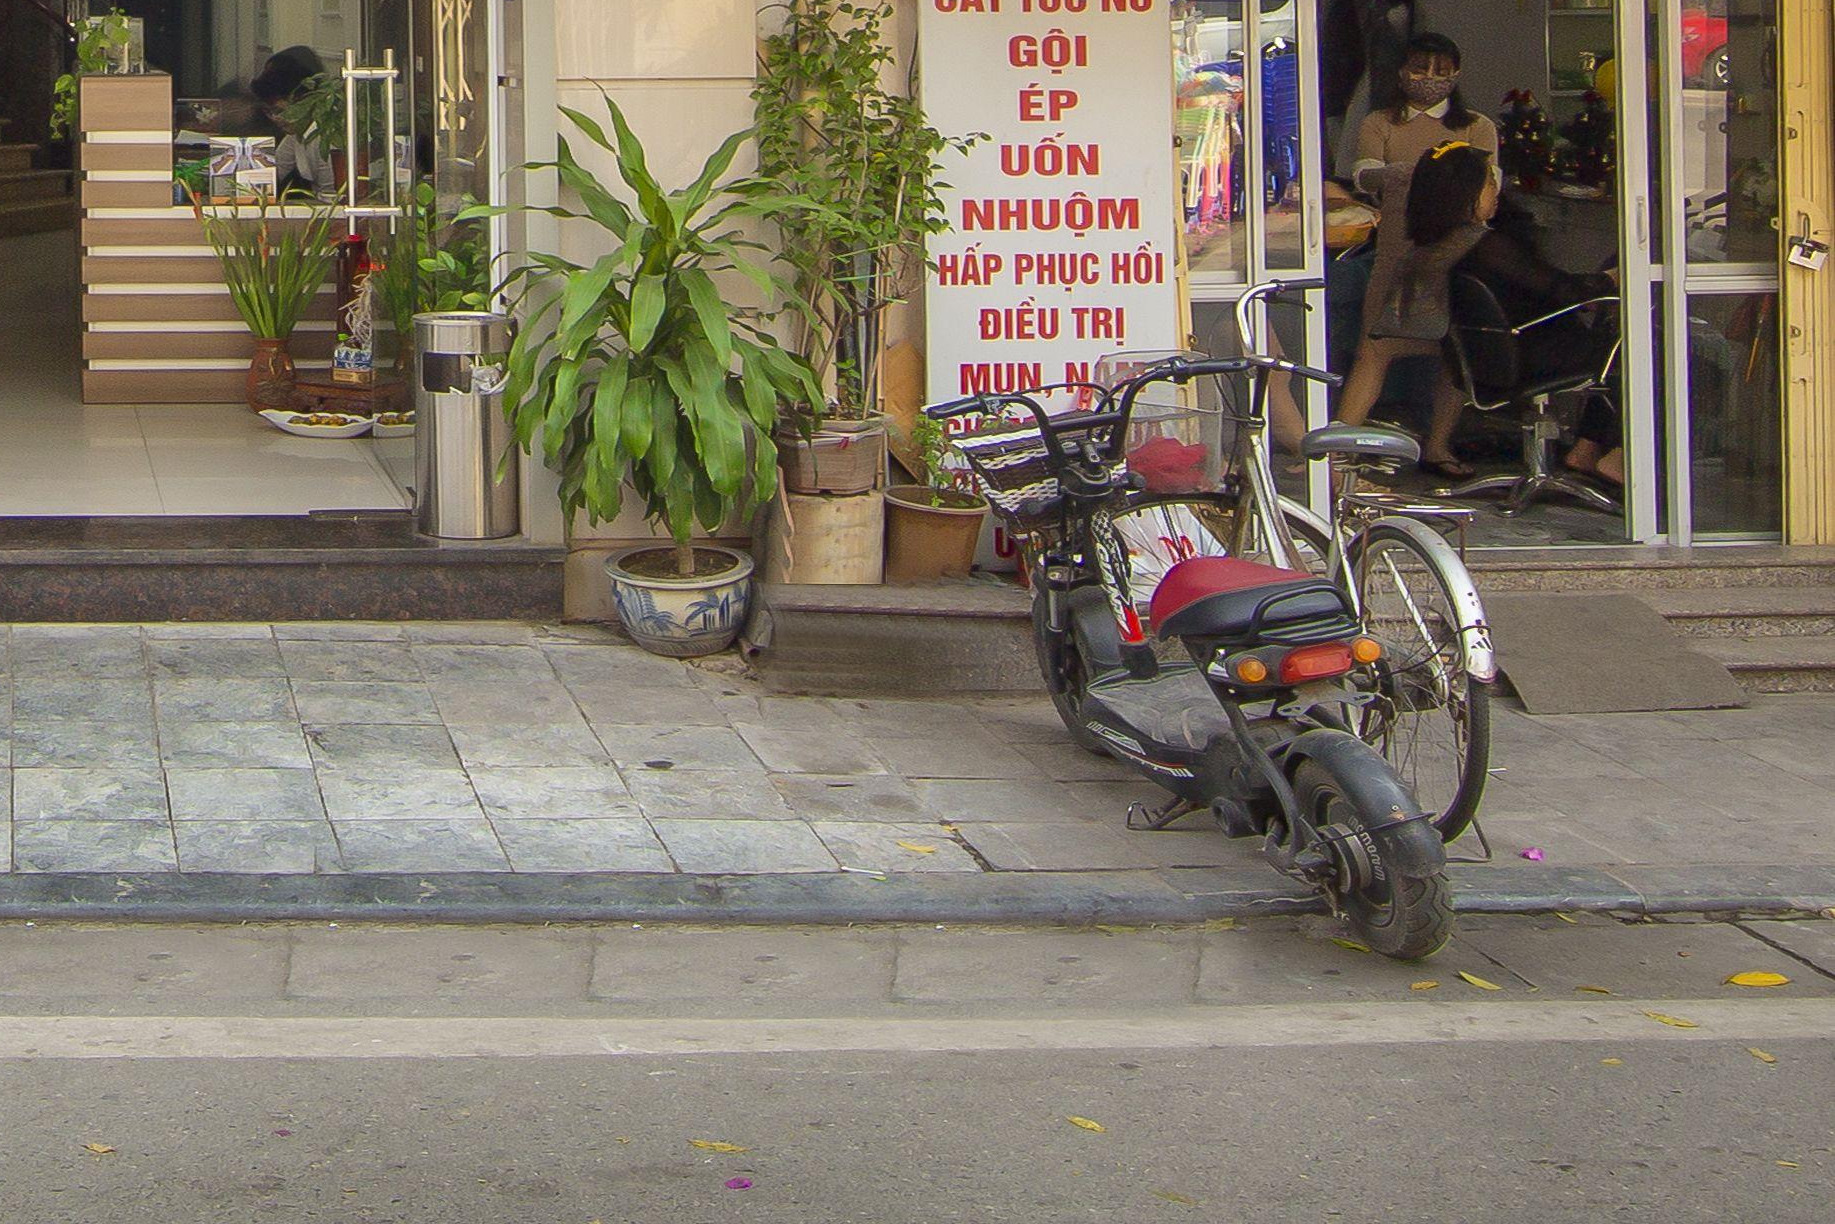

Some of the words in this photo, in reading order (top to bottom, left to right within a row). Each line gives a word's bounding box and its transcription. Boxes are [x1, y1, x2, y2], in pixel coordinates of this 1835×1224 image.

[1008, 29, 1089, 74] GỘI
[1019, 82, 1079, 122] ÉP
[1001, 133, 1100, 177] UỐN
[962, 194, 1141, 239] NHUỘM
[938, 241, 1003, 286] HẤP
[1014, 252, 1100, 294] PHỤC
[1111, 240, 1164, 285] HỒI
[979, 296, 1060, 341] ĐIỀU
[1072, 307, 1127, 347] TRỊ
